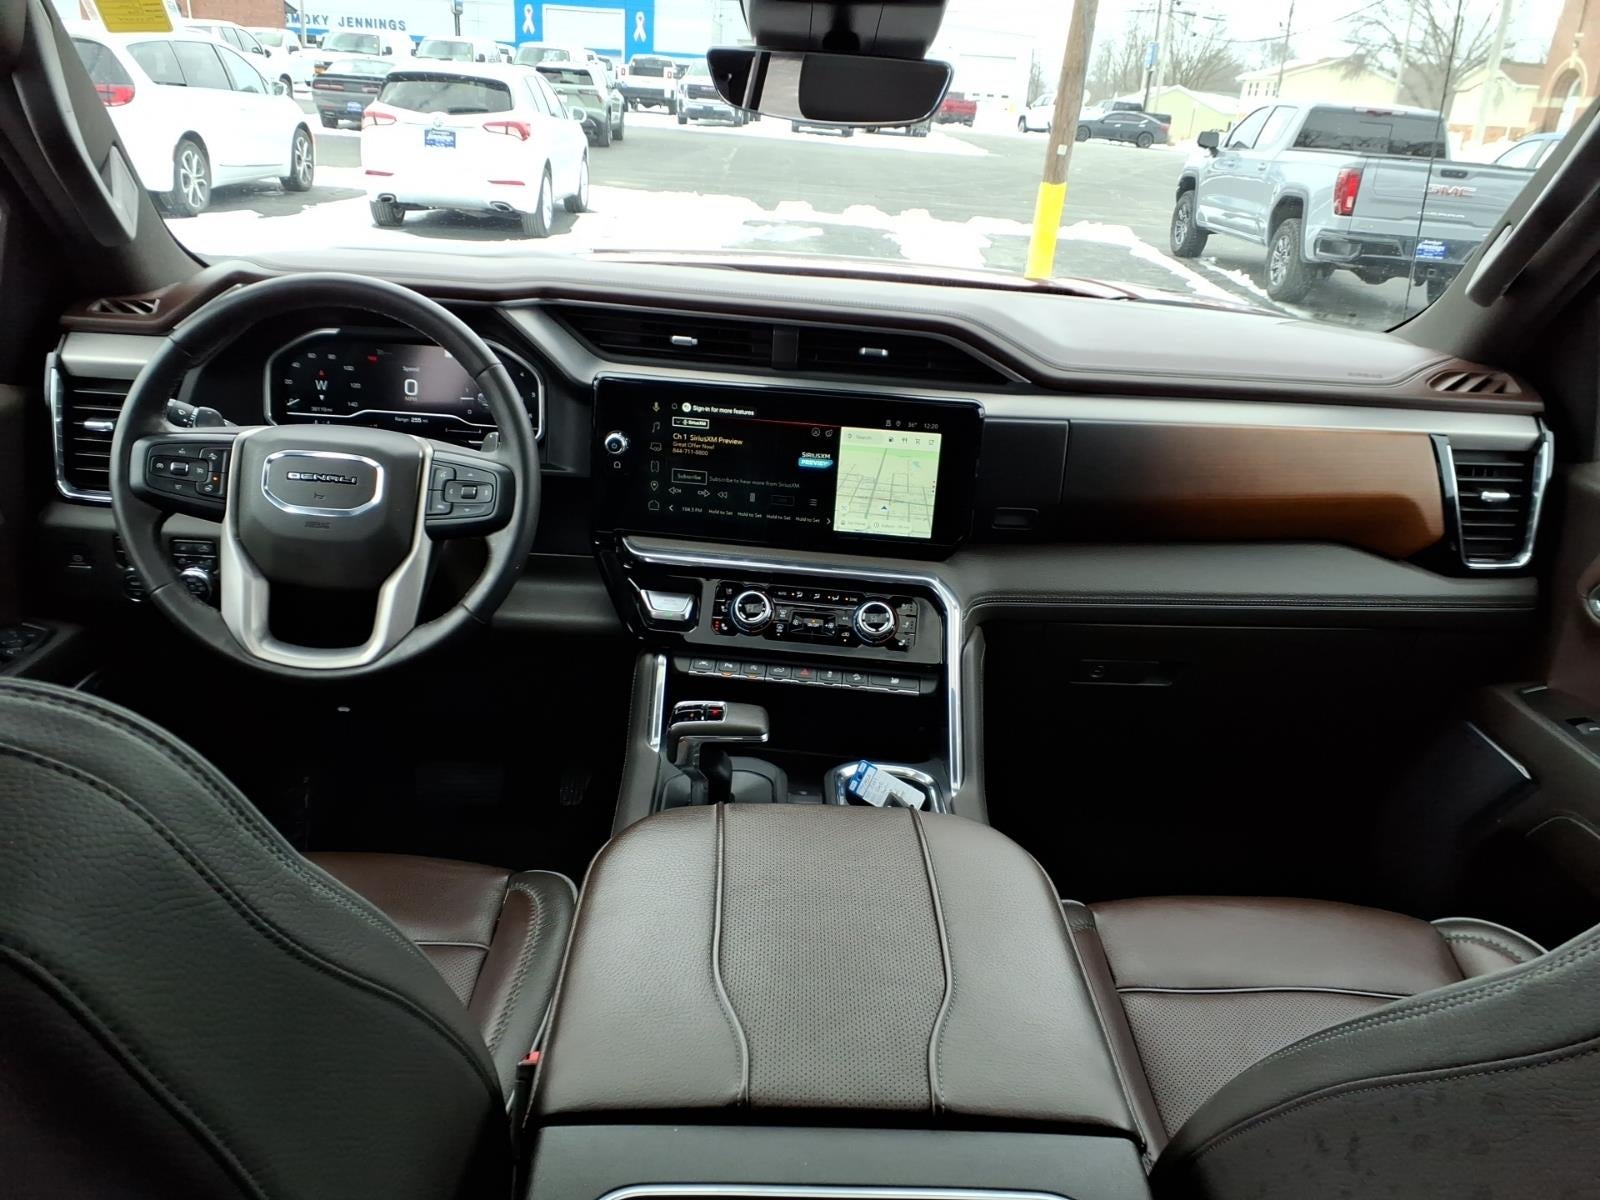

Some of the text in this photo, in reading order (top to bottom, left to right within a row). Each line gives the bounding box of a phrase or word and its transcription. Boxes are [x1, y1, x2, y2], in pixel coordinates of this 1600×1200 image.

[338, 16, 407, 32] JENNINGS
[314, 379, 328, 391] W
[404, 378, 418, 396] 0
[733, 407, 755, 416] features
[672, 432, 744, 445] Ch 1 SiriusXM Preview
[287, 471, 358, 485] DENALI
